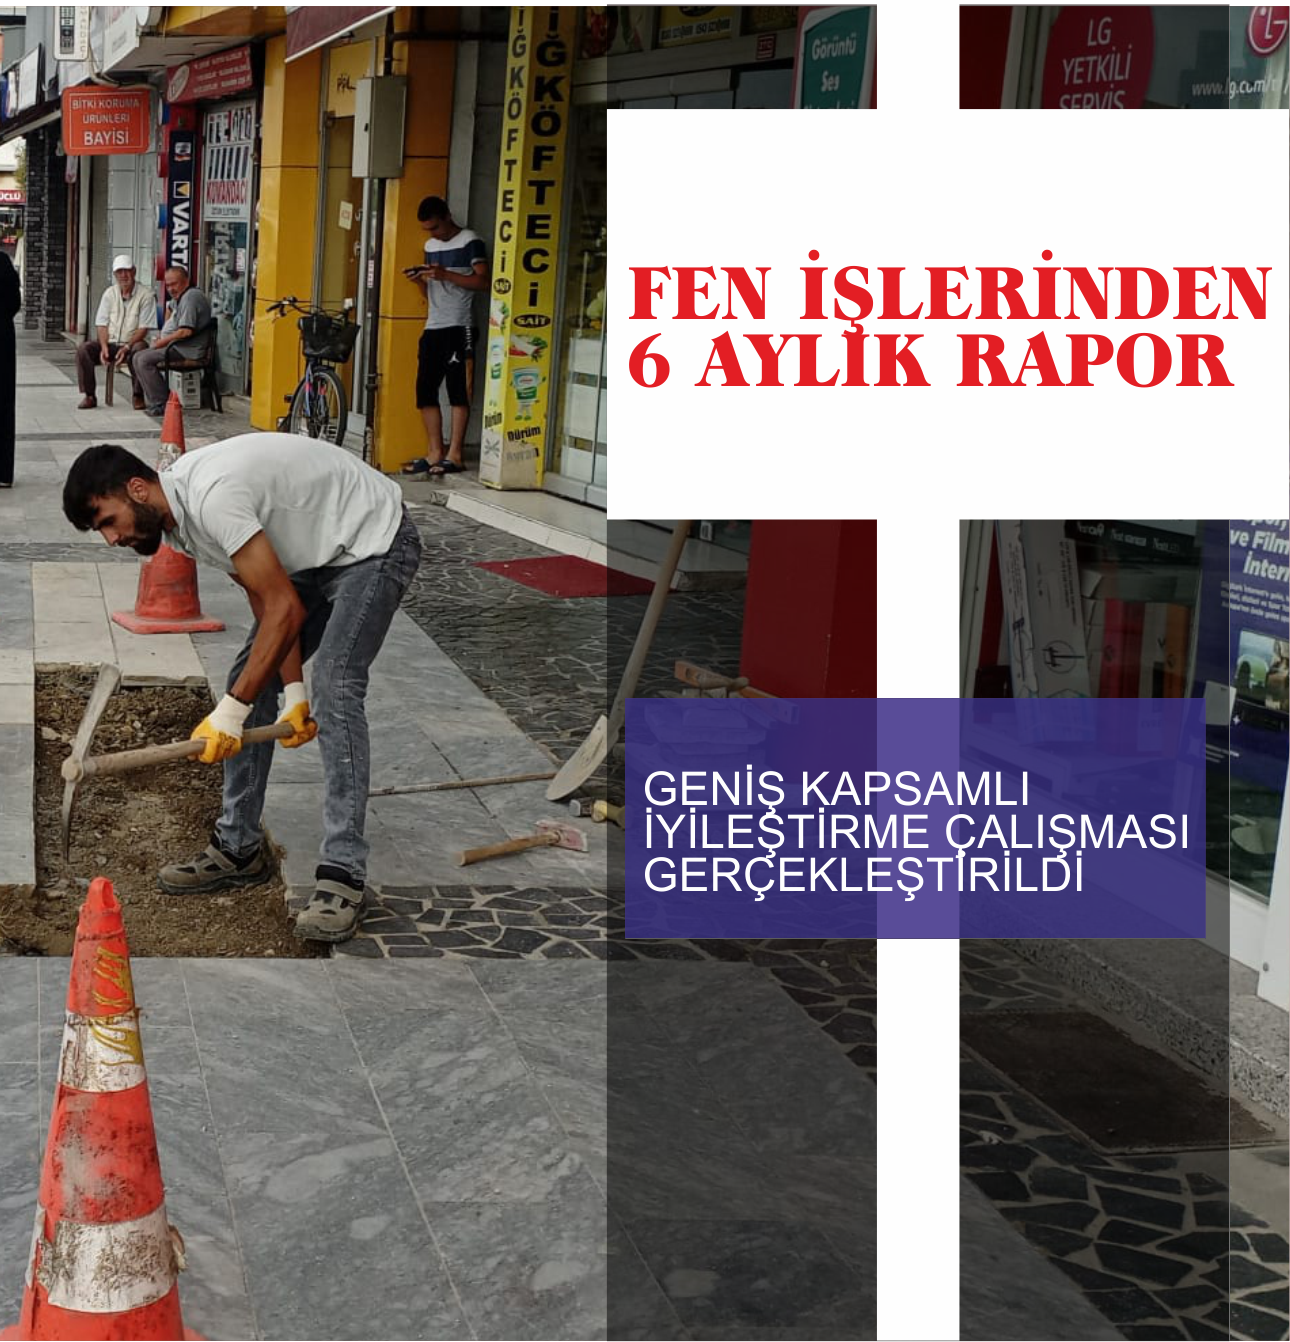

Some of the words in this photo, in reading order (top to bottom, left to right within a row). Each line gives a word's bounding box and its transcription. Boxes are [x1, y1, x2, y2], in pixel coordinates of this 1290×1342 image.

[1087, 17, 1112, 47] LG
[811, 33, 857, 61] Görüntü
[1063, 45, 1132, 85] YETKİLİ
[821, 71, 840, 92] Ses
[84, 127, 129, 146] BAYİSİ
[517, 315, 547, 327] SAİT
[507, 425, 542, 442] Dürüm
[1229, 528, 1250, 547] ve
